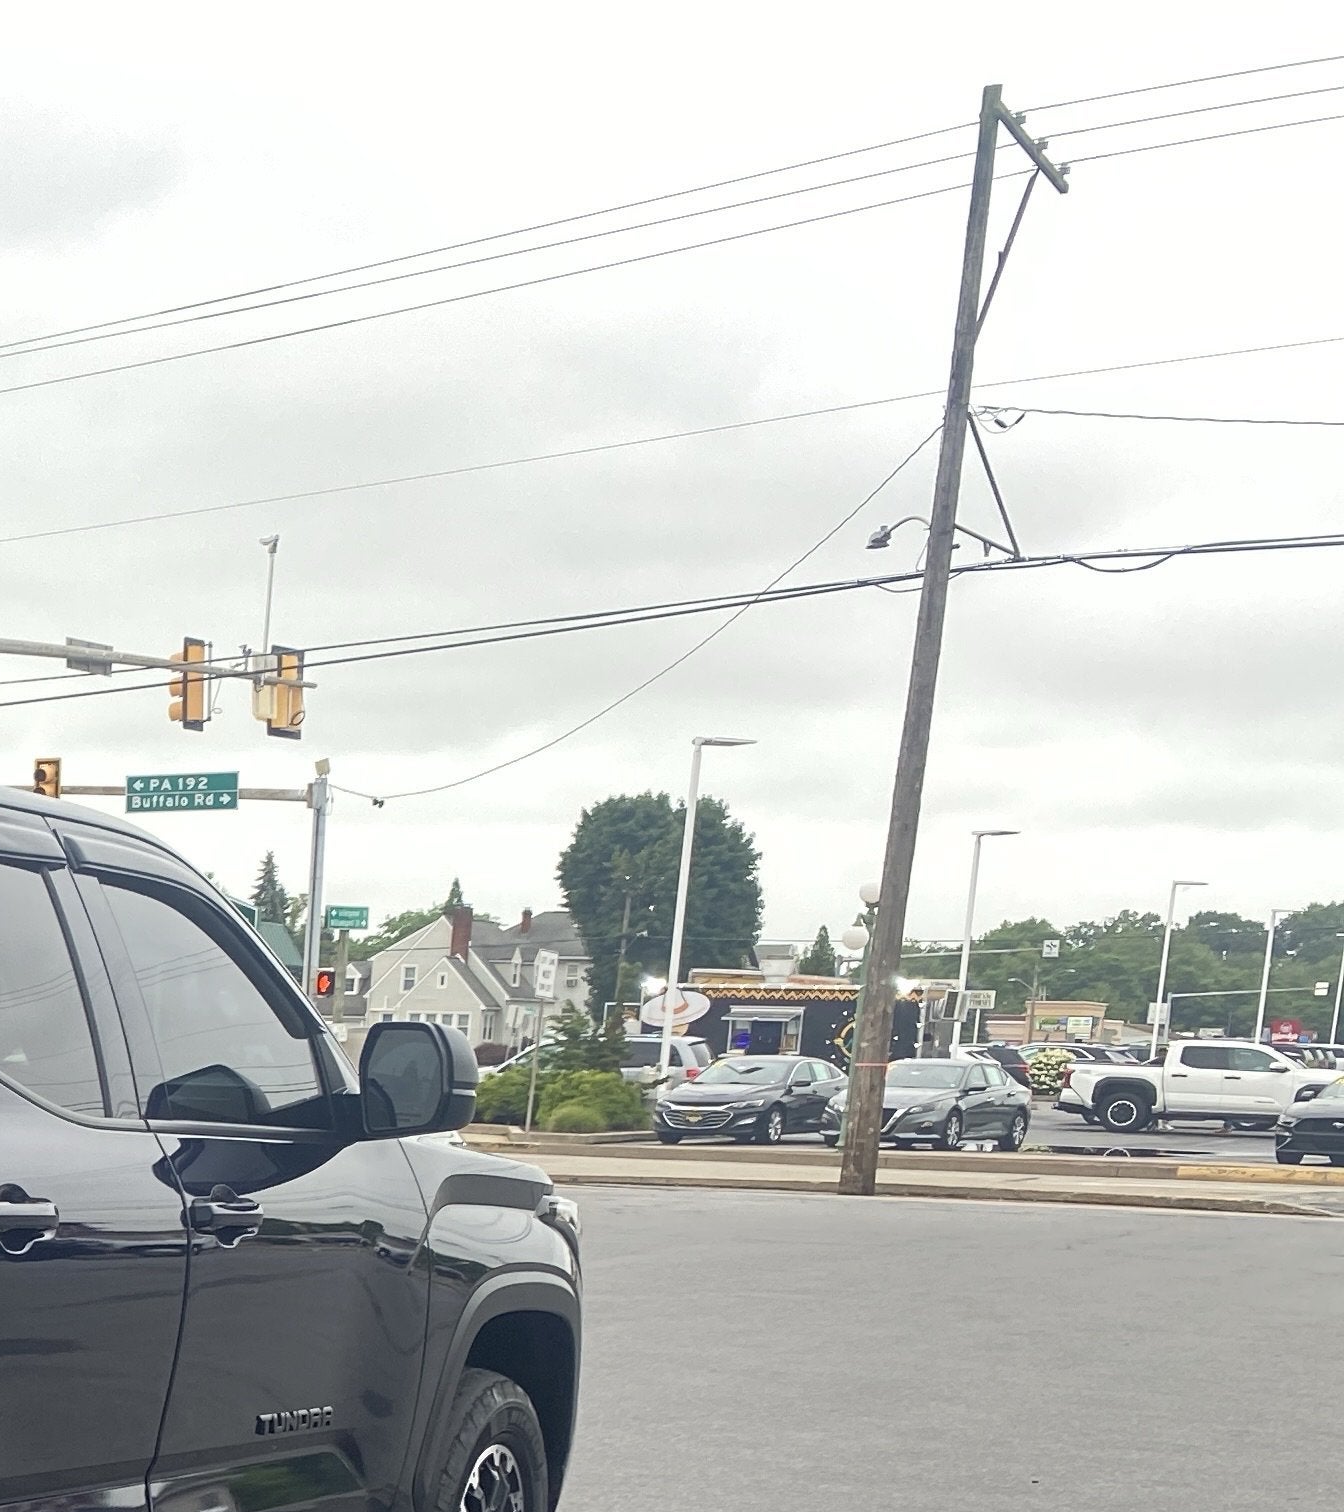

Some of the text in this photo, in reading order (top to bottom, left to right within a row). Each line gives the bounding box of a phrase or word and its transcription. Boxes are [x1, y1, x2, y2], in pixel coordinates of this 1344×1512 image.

[149, 776, 209, 791] PA 192
[131, 793, 214, 809] Buffalo Rd
[255, 1405, 334, 1435] TUNDRA
